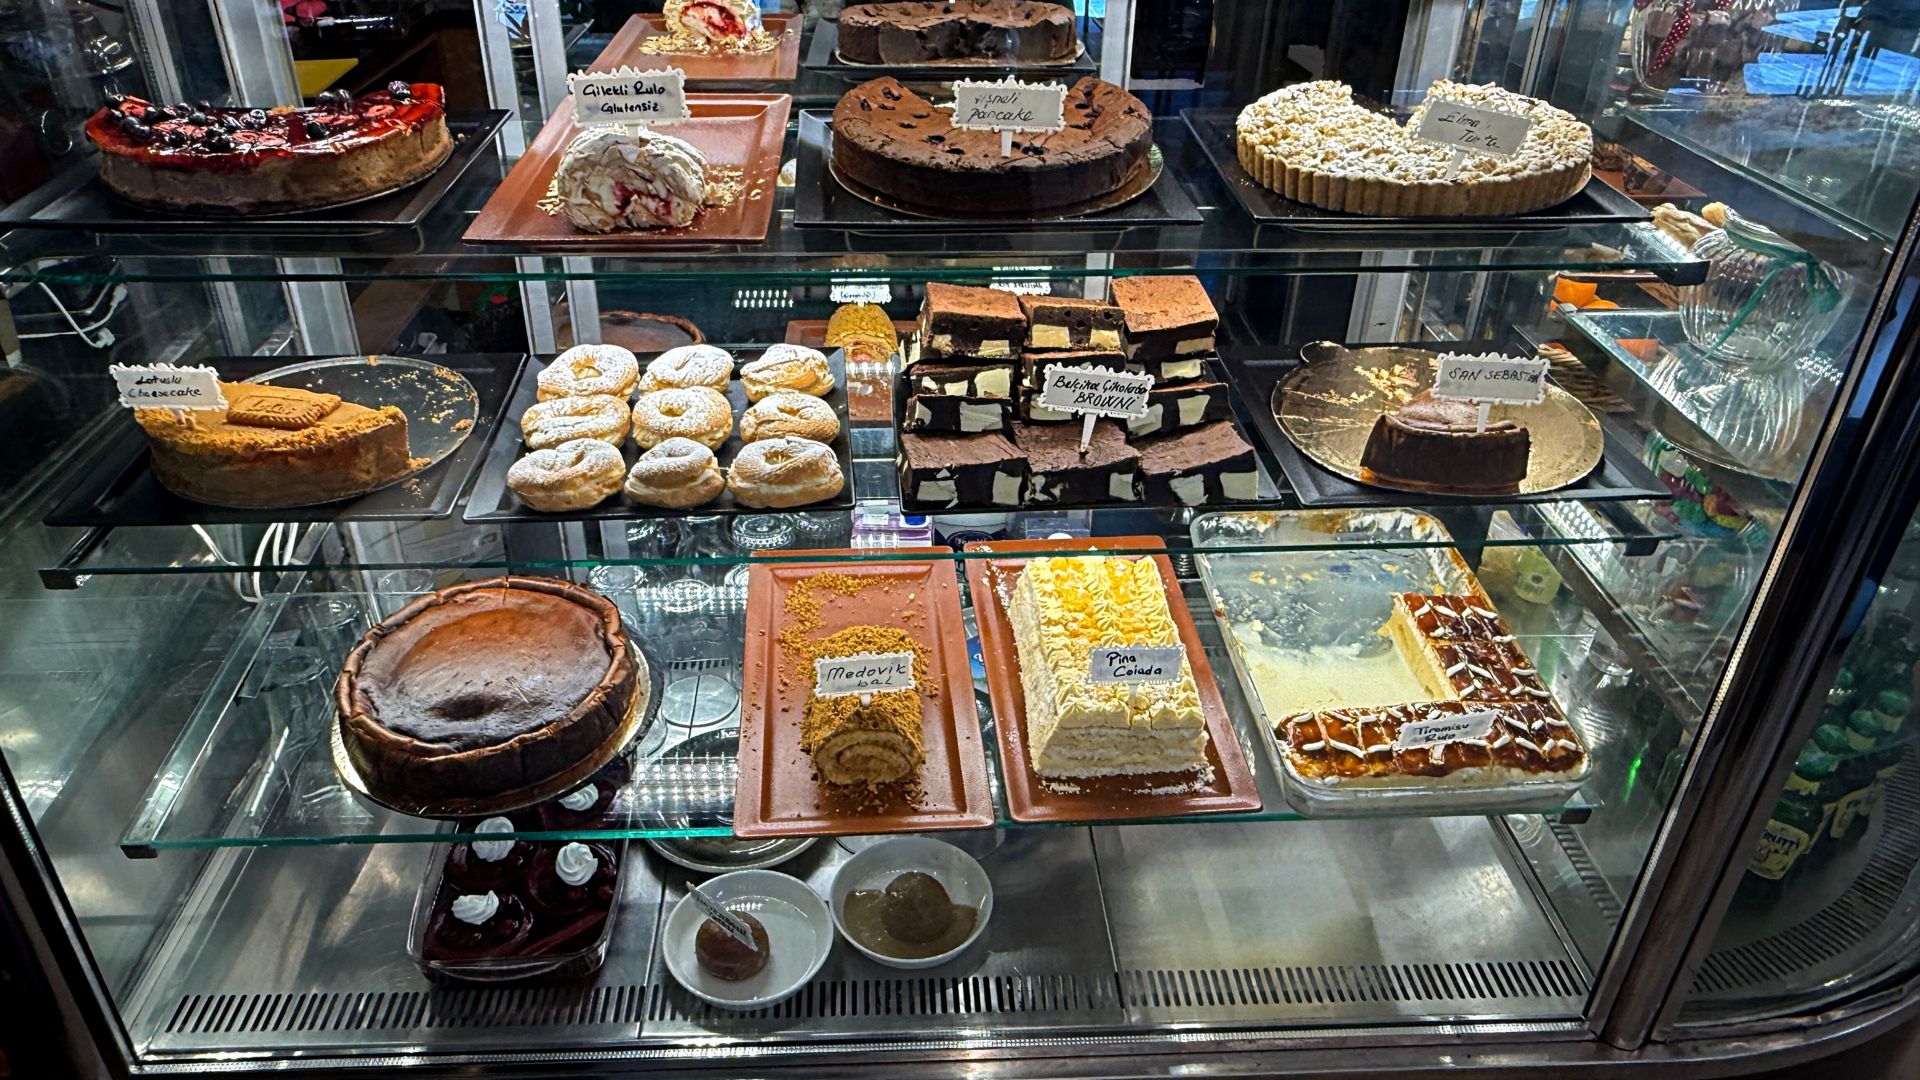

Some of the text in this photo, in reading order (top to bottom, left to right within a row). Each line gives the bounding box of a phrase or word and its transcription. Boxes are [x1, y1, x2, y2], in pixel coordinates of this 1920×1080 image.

[633, 80, 666, 96] Rulo
[1448, 367, 1482, 381] SAN
[826, 661, 907, 682] Medovik
